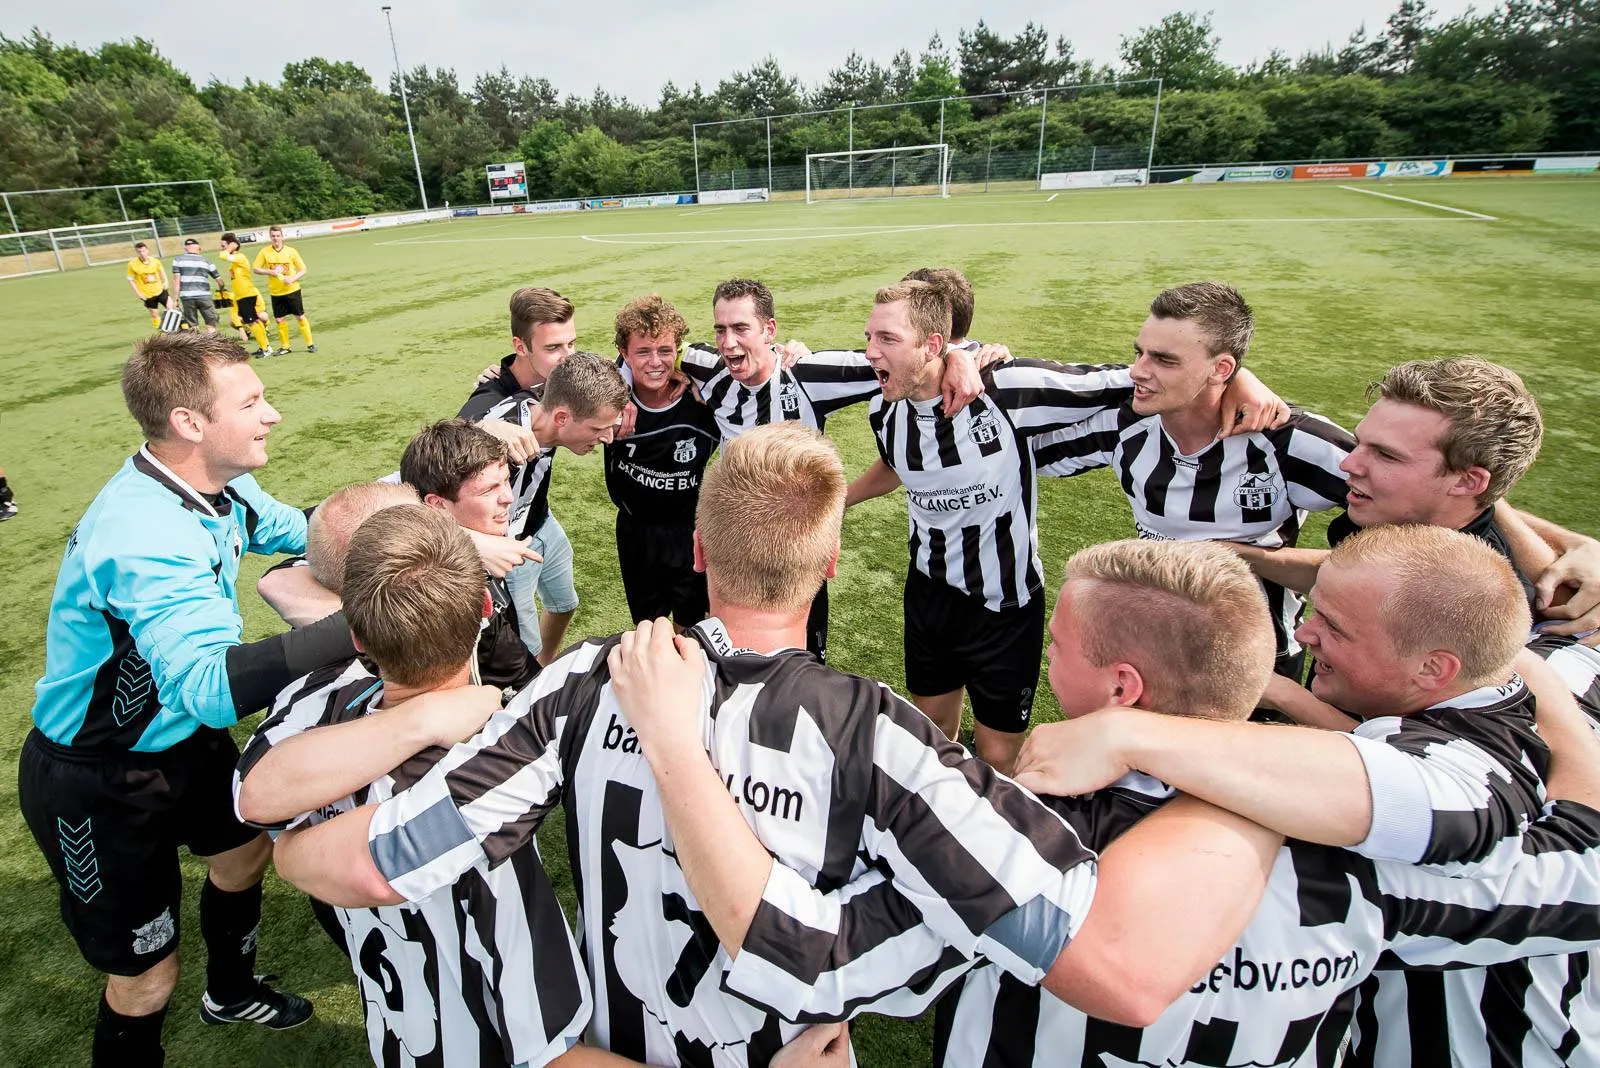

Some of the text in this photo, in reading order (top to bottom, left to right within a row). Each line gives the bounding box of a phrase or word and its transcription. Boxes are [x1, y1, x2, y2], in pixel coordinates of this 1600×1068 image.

[626, 443, 637, 458] 7
[678, 474, 698, 491] B.V.
[974, 485, 1003, 505] B.V.
[1020, 687, 1032, 706] 2
